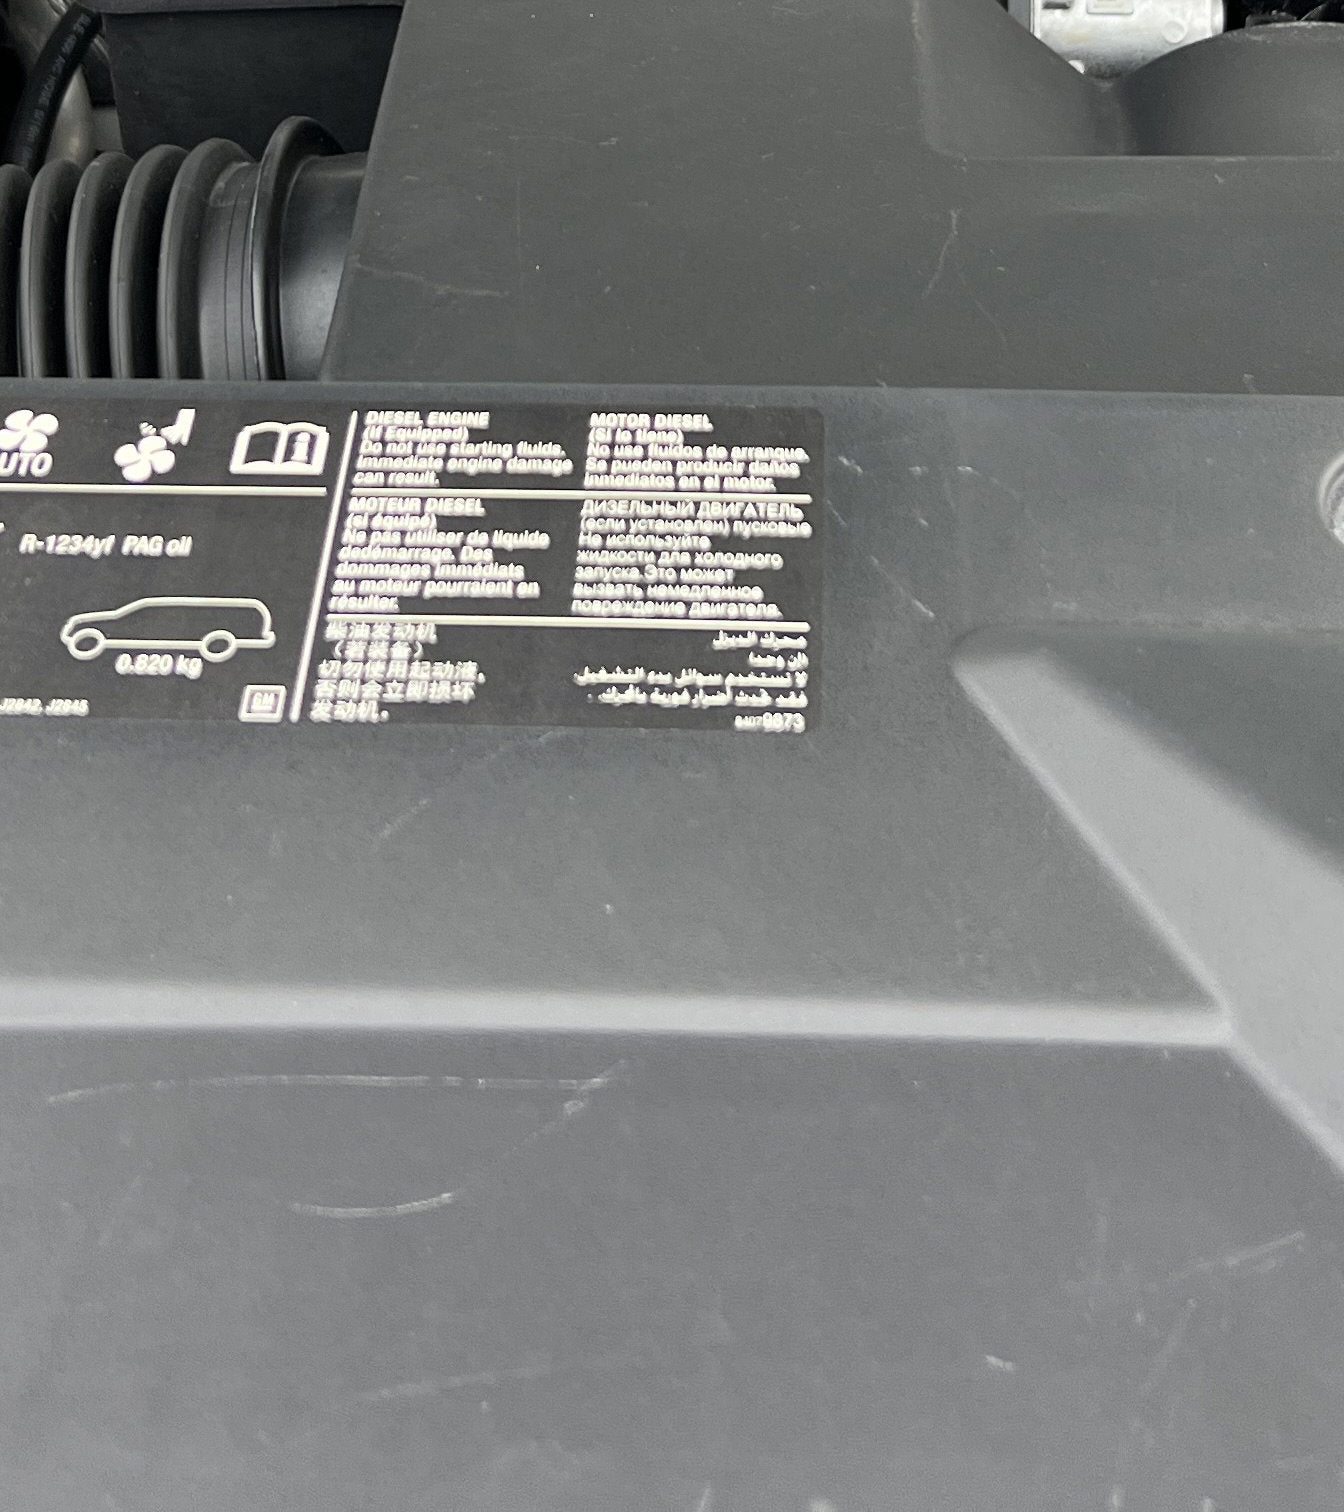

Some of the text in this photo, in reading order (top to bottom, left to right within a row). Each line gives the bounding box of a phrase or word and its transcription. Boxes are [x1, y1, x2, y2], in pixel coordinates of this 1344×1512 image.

[365, 410, 490, 429] DIESEL ENGINE
[590, 412, 714, 432] MOTOR DIESEL
[385, 426, 469, 443] Equipped)
[615, 428, 633, 444] lo
[635, 429, 684, 446] tiene)
[359, 440, 382, 455] Do
[385, 441, 413, 456] not
[416, 442, 447, 456] use
[449, 440, 513, 459] starting
[587, 443, 610, 458] No
[613, 445, 644, 459] use
[647, 444, 703, 460] fluidos
[706, 444, 728, 461] de
[357, 455, 574, 477] Immediate engine damage
[585, 457, 800, 479] Se pueden producir daños
[352, 470, 440, 487] can result.
[678, 476, 700, 491] en
[704, 474, 721, 491] el
[348, 497, 486, 517] MOTEUR DIESEL
[580, 498, 805, 522] ДИЗЕЛЬНЫЙ ДВИГАТЕЛЬ
[580, 517, 626, 533] (если
[733, 520, 813, 539] пусковые
[19, 533, 193, 560] R-1234yf PAG oil
[340, 529, 551, 551] Ne pas utiliser de liquide
[578, 532, 712, 551] Не используйте
[459, 546, 494, 563] Des
[576, 549, 784, 570] жидкости для холодного
[334, 562, 431, 582] dommages
[679, 567, 735, 585] может
[331, 579, 541, 600] au moteur pourraient en
[325, 622, 438, 644] 柴油发动机
[115, 653, 203, 679] 0.820 kg
[251, 691, 277, 712] GM
